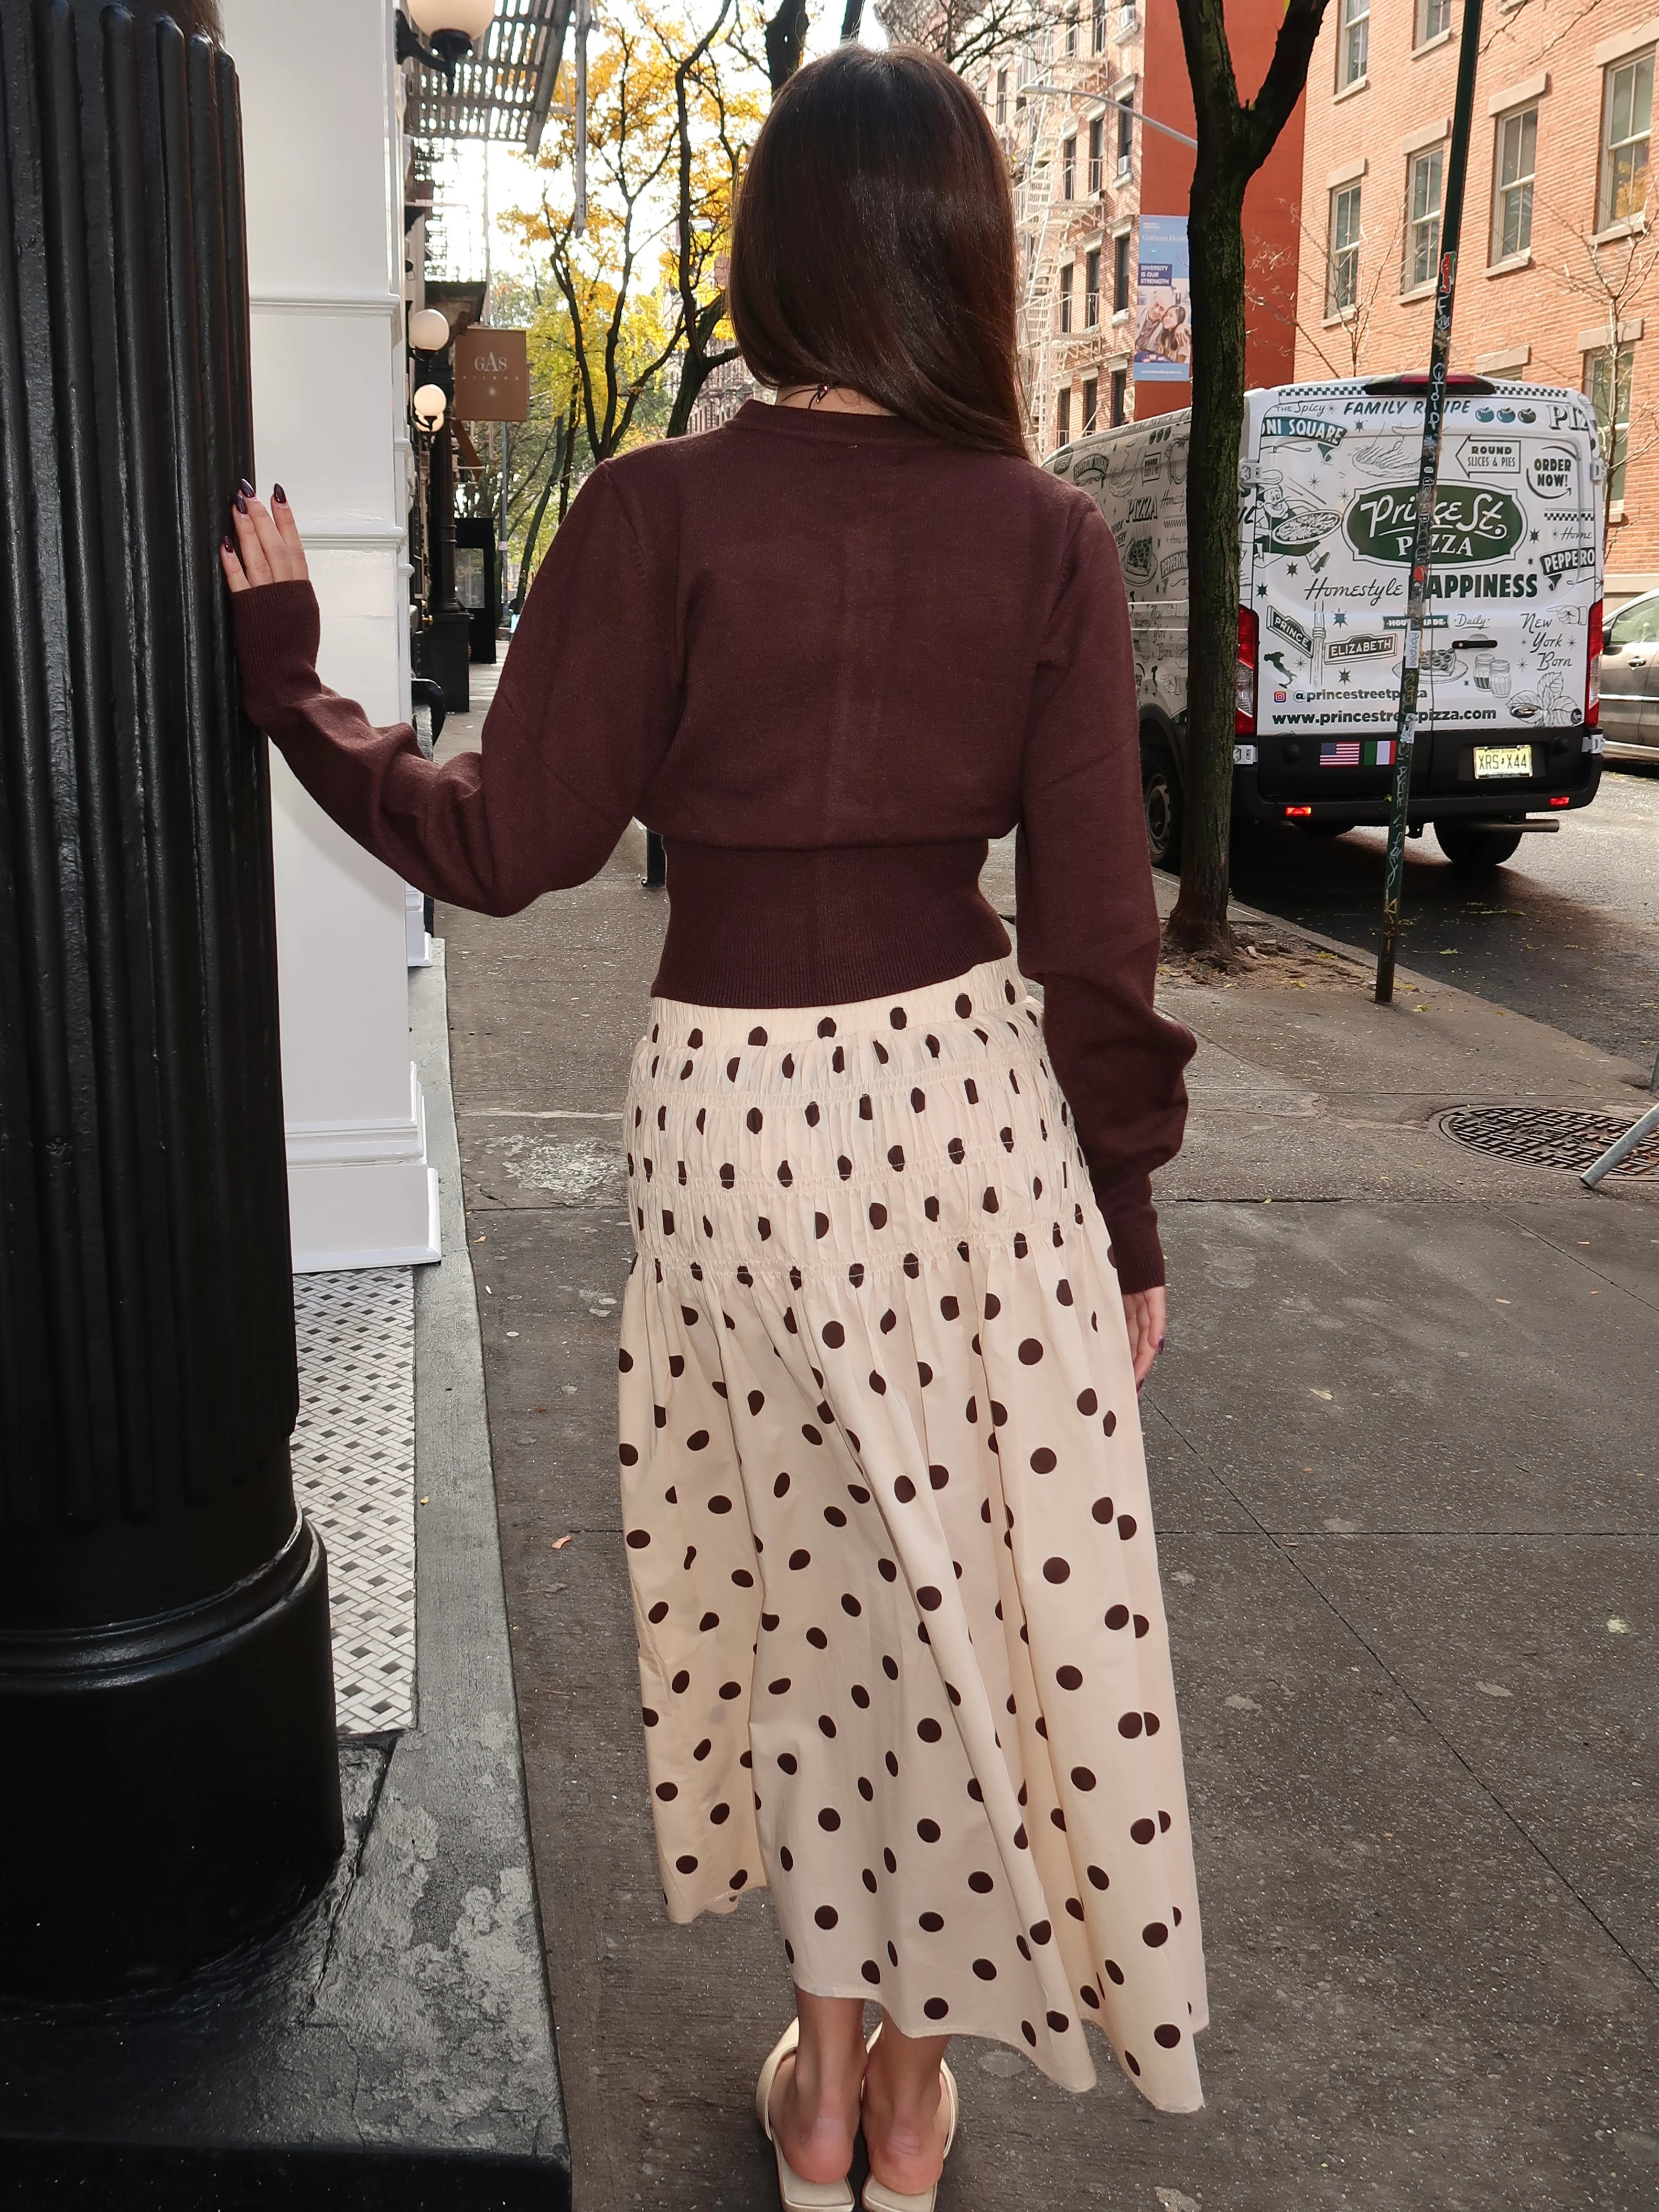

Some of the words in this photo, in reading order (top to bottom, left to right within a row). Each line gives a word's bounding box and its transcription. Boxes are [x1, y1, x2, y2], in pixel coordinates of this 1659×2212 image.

[475, 351, 508, 372] GAS
[1294, 401, 1326, 417] Spicy
[1343, 400, 1407, 415] FAMILY
[1413, 400, 1471, 414] RIPE
[1289, 420, 1344, 444] SQUARE
[1472, 446, 1512, 455] ROUND
[1468, 456, 1489, 467] SLICES
[1493, 457, 1497, 467] &
[1501, 456, 1515, 467] PIES
[1534, 458, 1571, 471] ORDER
[1537, 474, 1568, 487] NOW!
[1126, 495, 1158, 523] PIZZA
[1360, 494, 1462, 538] Price
[1561, 527, 1592, 540] Home
[1396, 534, 1473, 557] PZZA
[1544, 549, 1595, 573] PEPPERO
[1304, 576, 1404, 606] Homestyle
[1409, 574, 1538, 599] APPINESS
[1455, 613, 1487, 627] Daily
[1520, 612, 1553, 634] New
[1274, 616, 1309, 648] PRINCE
[1331, 638, 1392, 656] ELIZABETH
[1529, 632, 1563, 653] York
[1536, 651, 1572, 671] Born
[1479, 754, 1499, 770] XRS
[1506, 753, 1527, 769] X44
